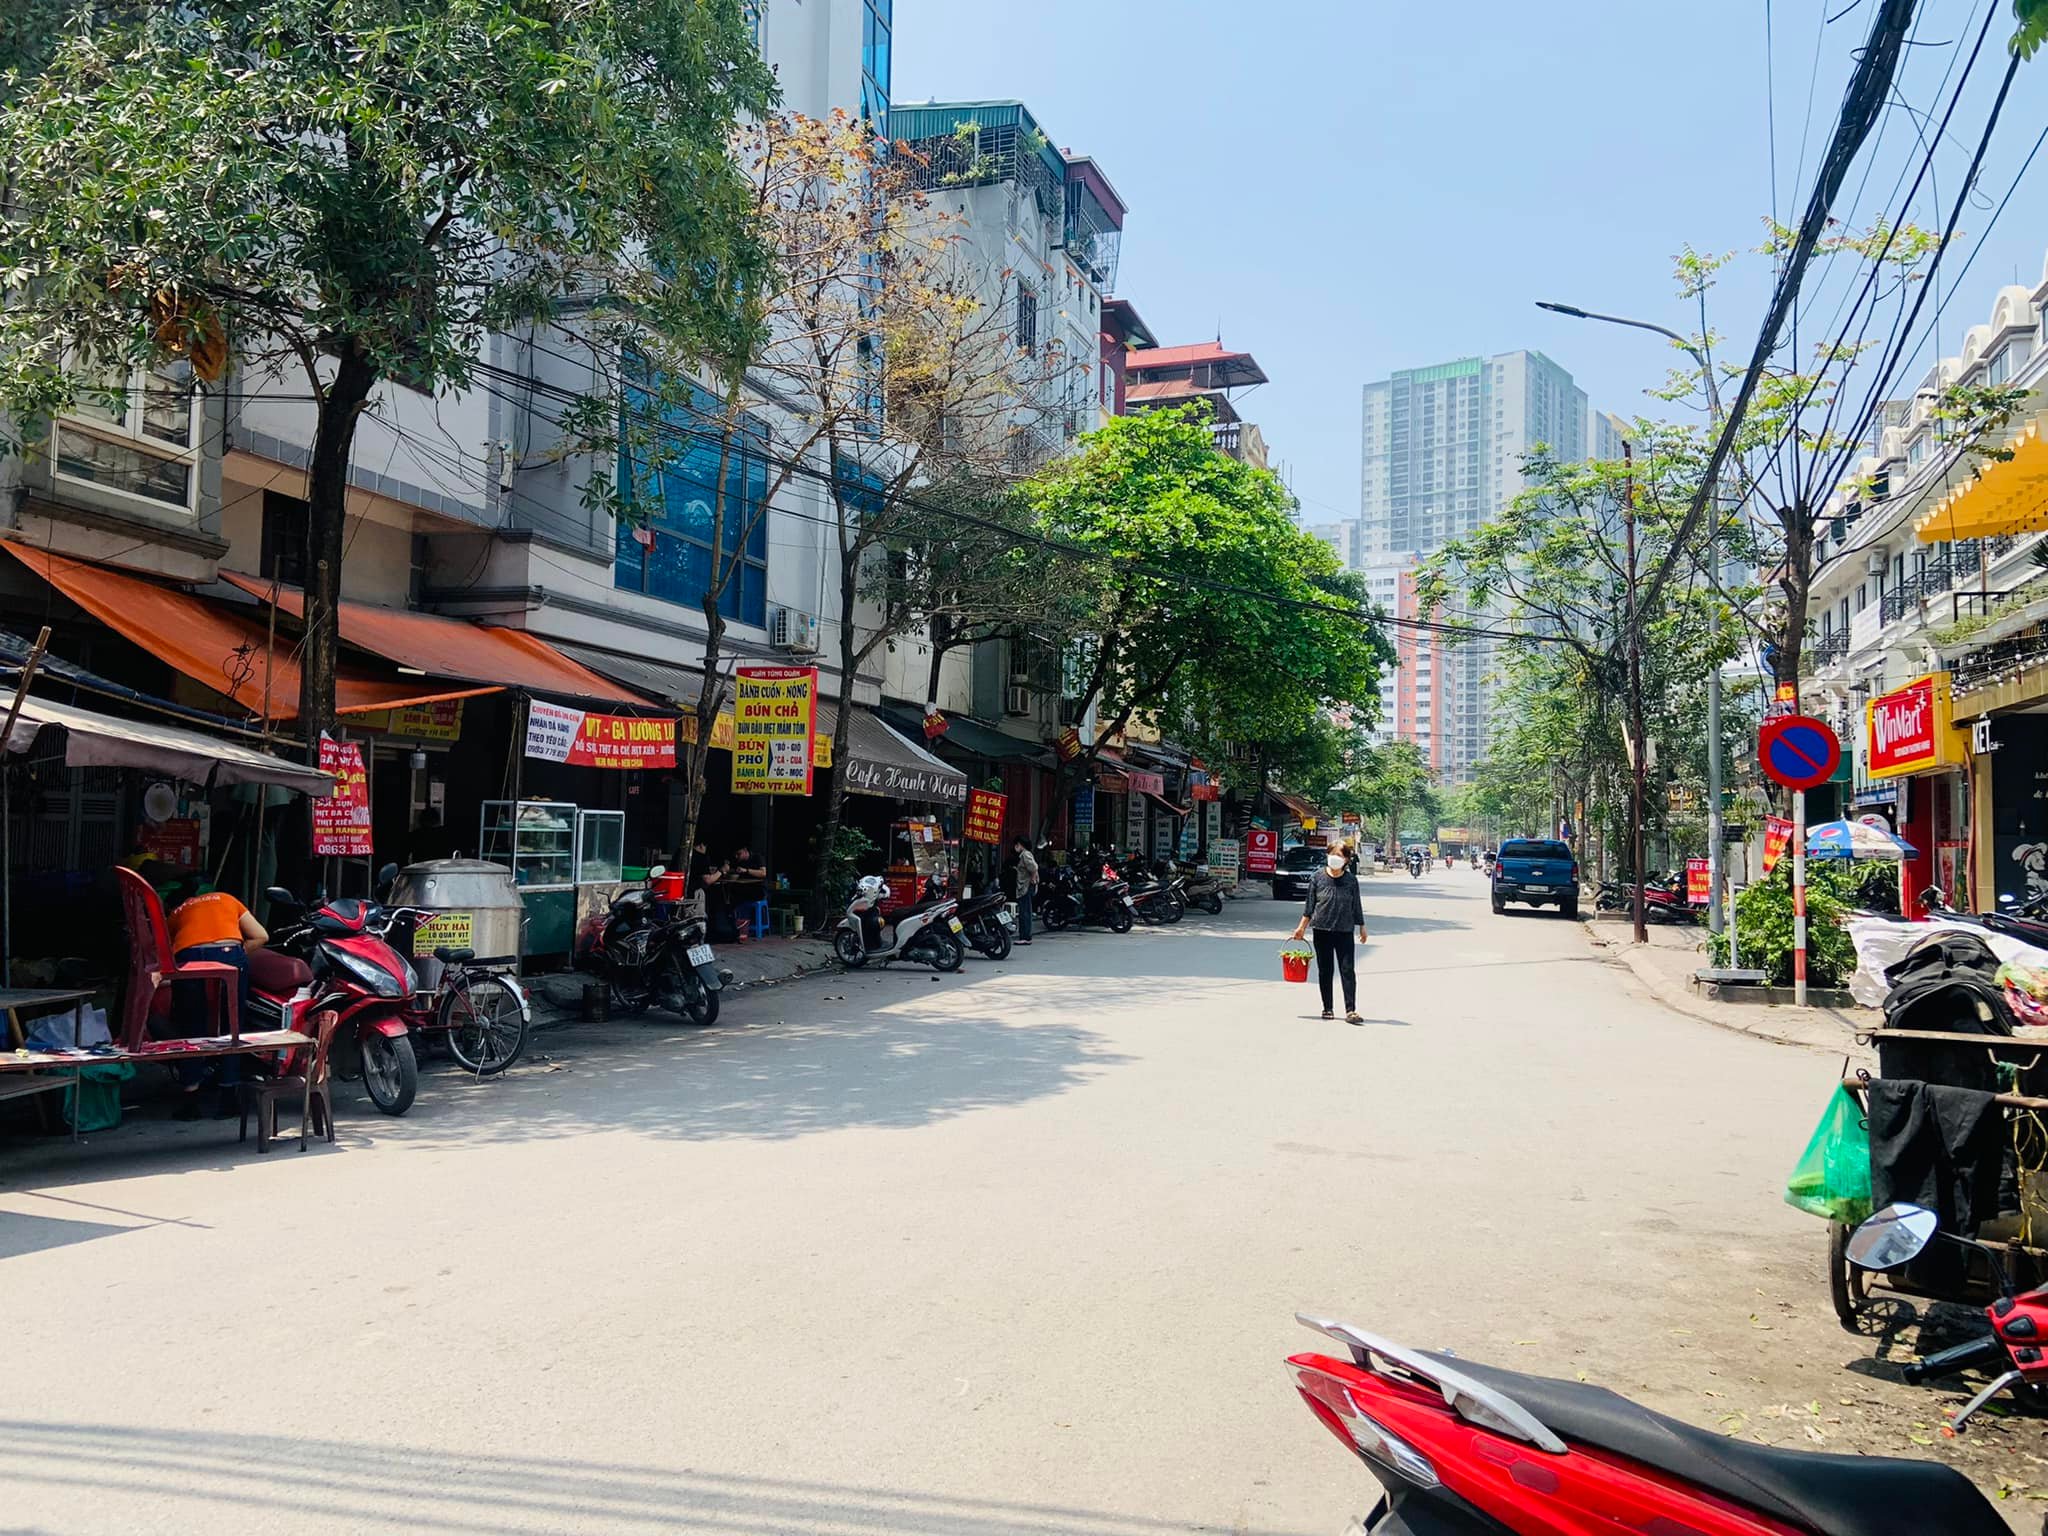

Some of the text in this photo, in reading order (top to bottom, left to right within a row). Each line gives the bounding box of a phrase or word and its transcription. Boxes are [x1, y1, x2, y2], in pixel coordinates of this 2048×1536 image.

[739, 681, 759, 698] BÁNH
[761, 681, 781, 698] CUỐN
[786, 681, 808, 698] NÓNG
[745, 701, 799, 717] BÚN CHẢ
[628, 719, 662, 741] NƯỚNG
[1972, 712, 1991, 754] KẾT
[528, 732, 544, 743] THEO
[546, 735, 557, 745] YÊU
[738, 739, 765, 751] BÚN
[737, 752, 763, 764] PHỞ
[735, 780, 802, 793] TRỨNG VỊT LỘN
[845, 760, 881, 788] Cafe
[885, 766, 927, 793] Hạnh
[929, 774, 957, 799] Nga
